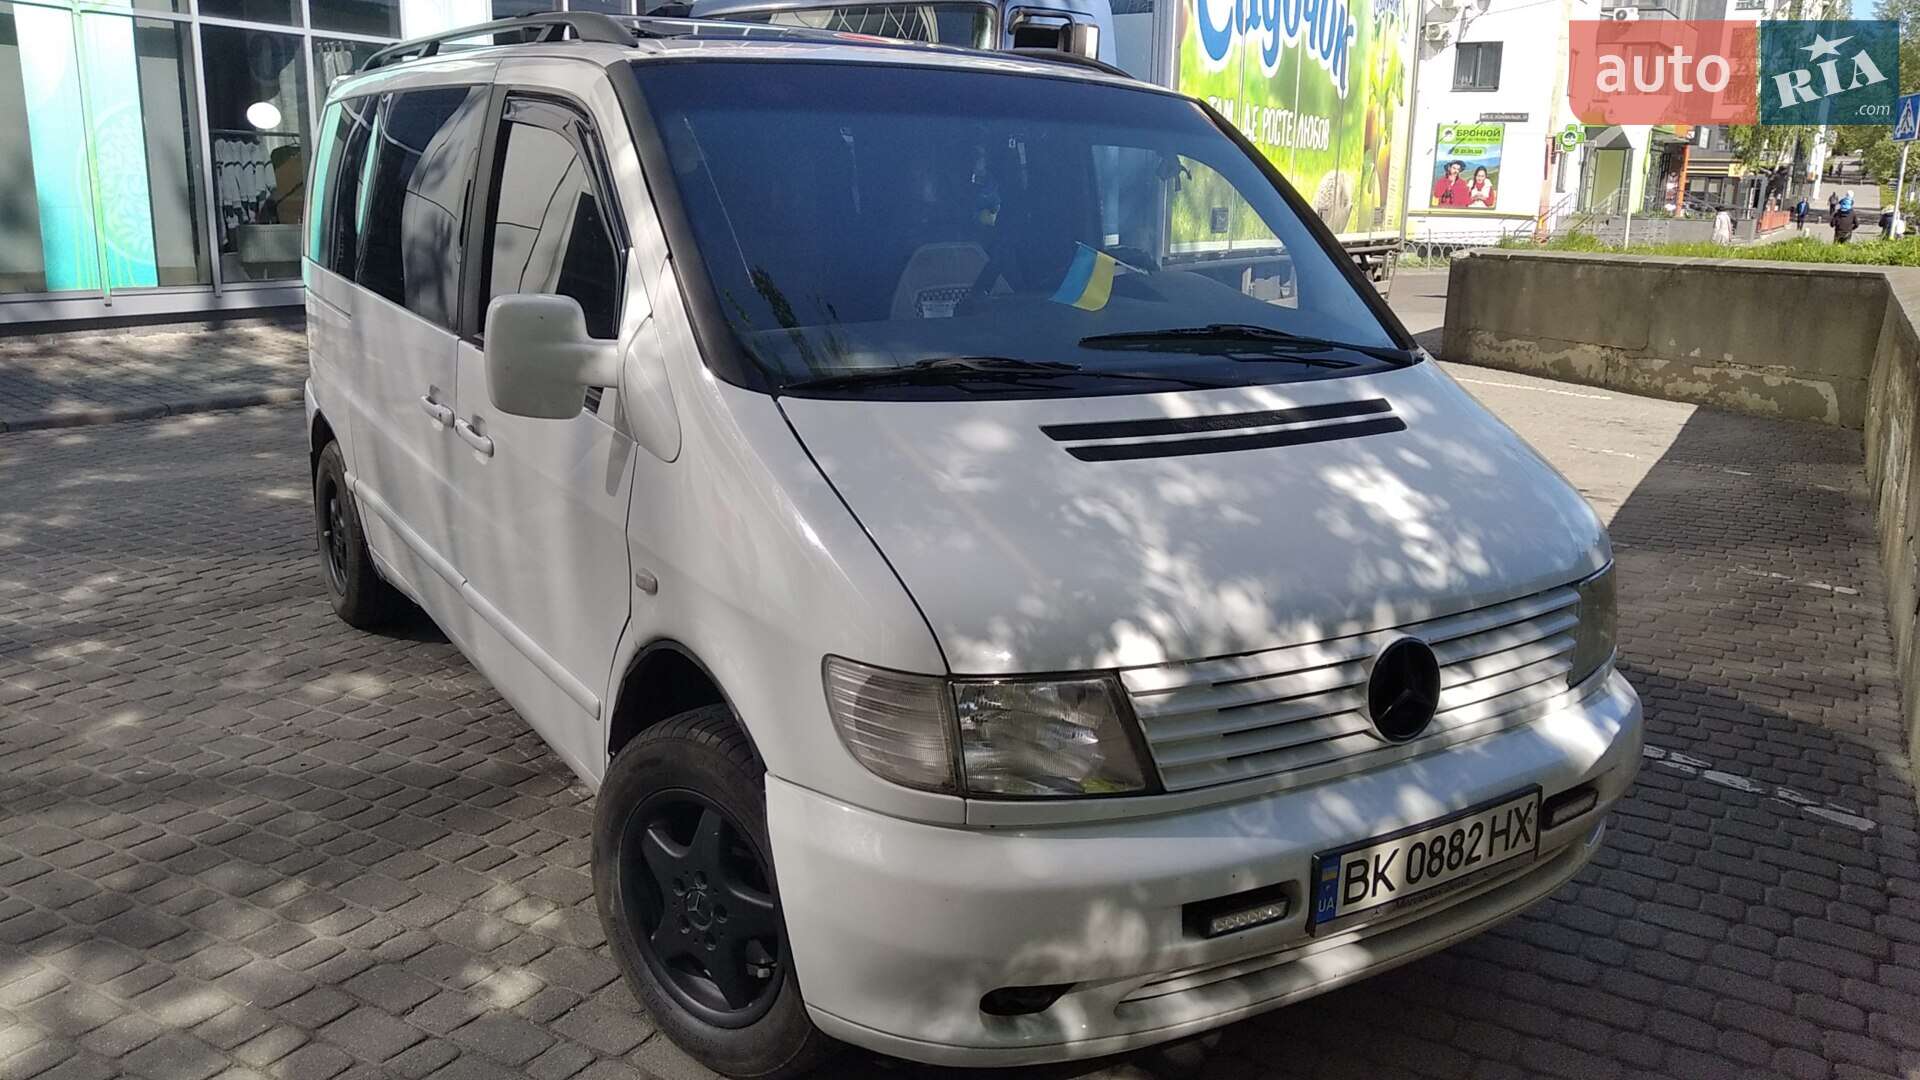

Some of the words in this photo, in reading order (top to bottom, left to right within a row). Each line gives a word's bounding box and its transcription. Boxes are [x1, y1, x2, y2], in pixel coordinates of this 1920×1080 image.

[1262, 107, 1293, 147] РОСТЕ
[1456, 127, 1501, 138] БРОНЮЙ
[1343, 848, 1400, 906] BK
[1405, 821, 1484, 885] 0882
[1488, 801, 1534, 857] HX
[1318, 899, 1336, 914] UA
